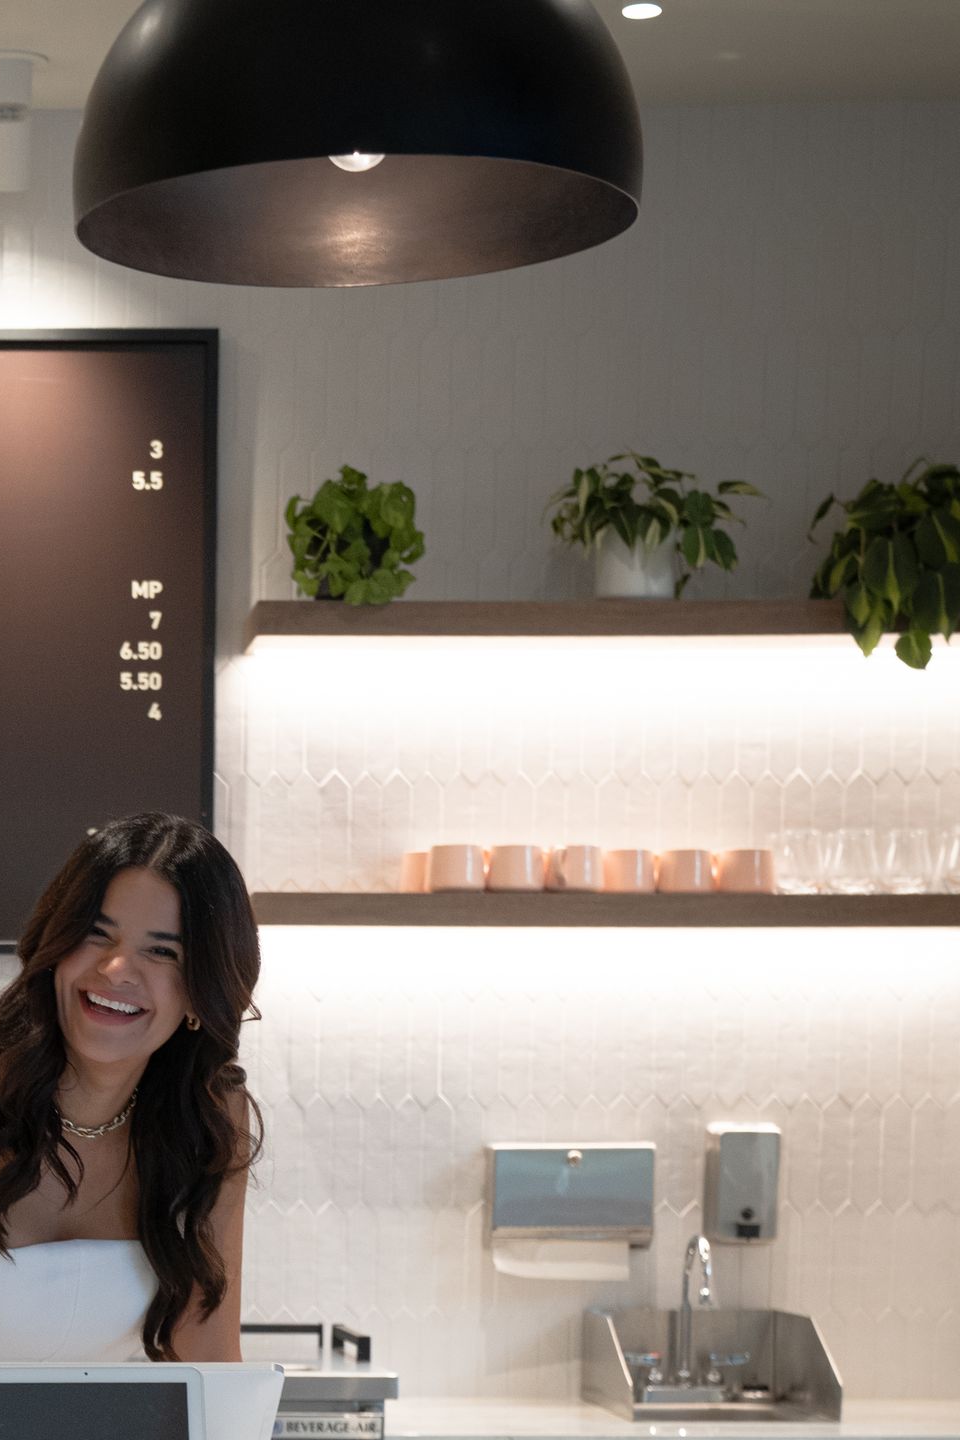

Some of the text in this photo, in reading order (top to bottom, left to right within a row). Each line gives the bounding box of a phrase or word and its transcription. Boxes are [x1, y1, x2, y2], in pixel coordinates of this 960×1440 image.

[149, 440, 163, 459] 3
[132, 470, 163, 491] 5.5
[131, 580, 163, 599] MP
[149, 611, 162, 630] 7
[119, 641, 162, 660] 6.50
[120, 672, 162, 691] 5.50
[148, 703, 162, 721] 4
